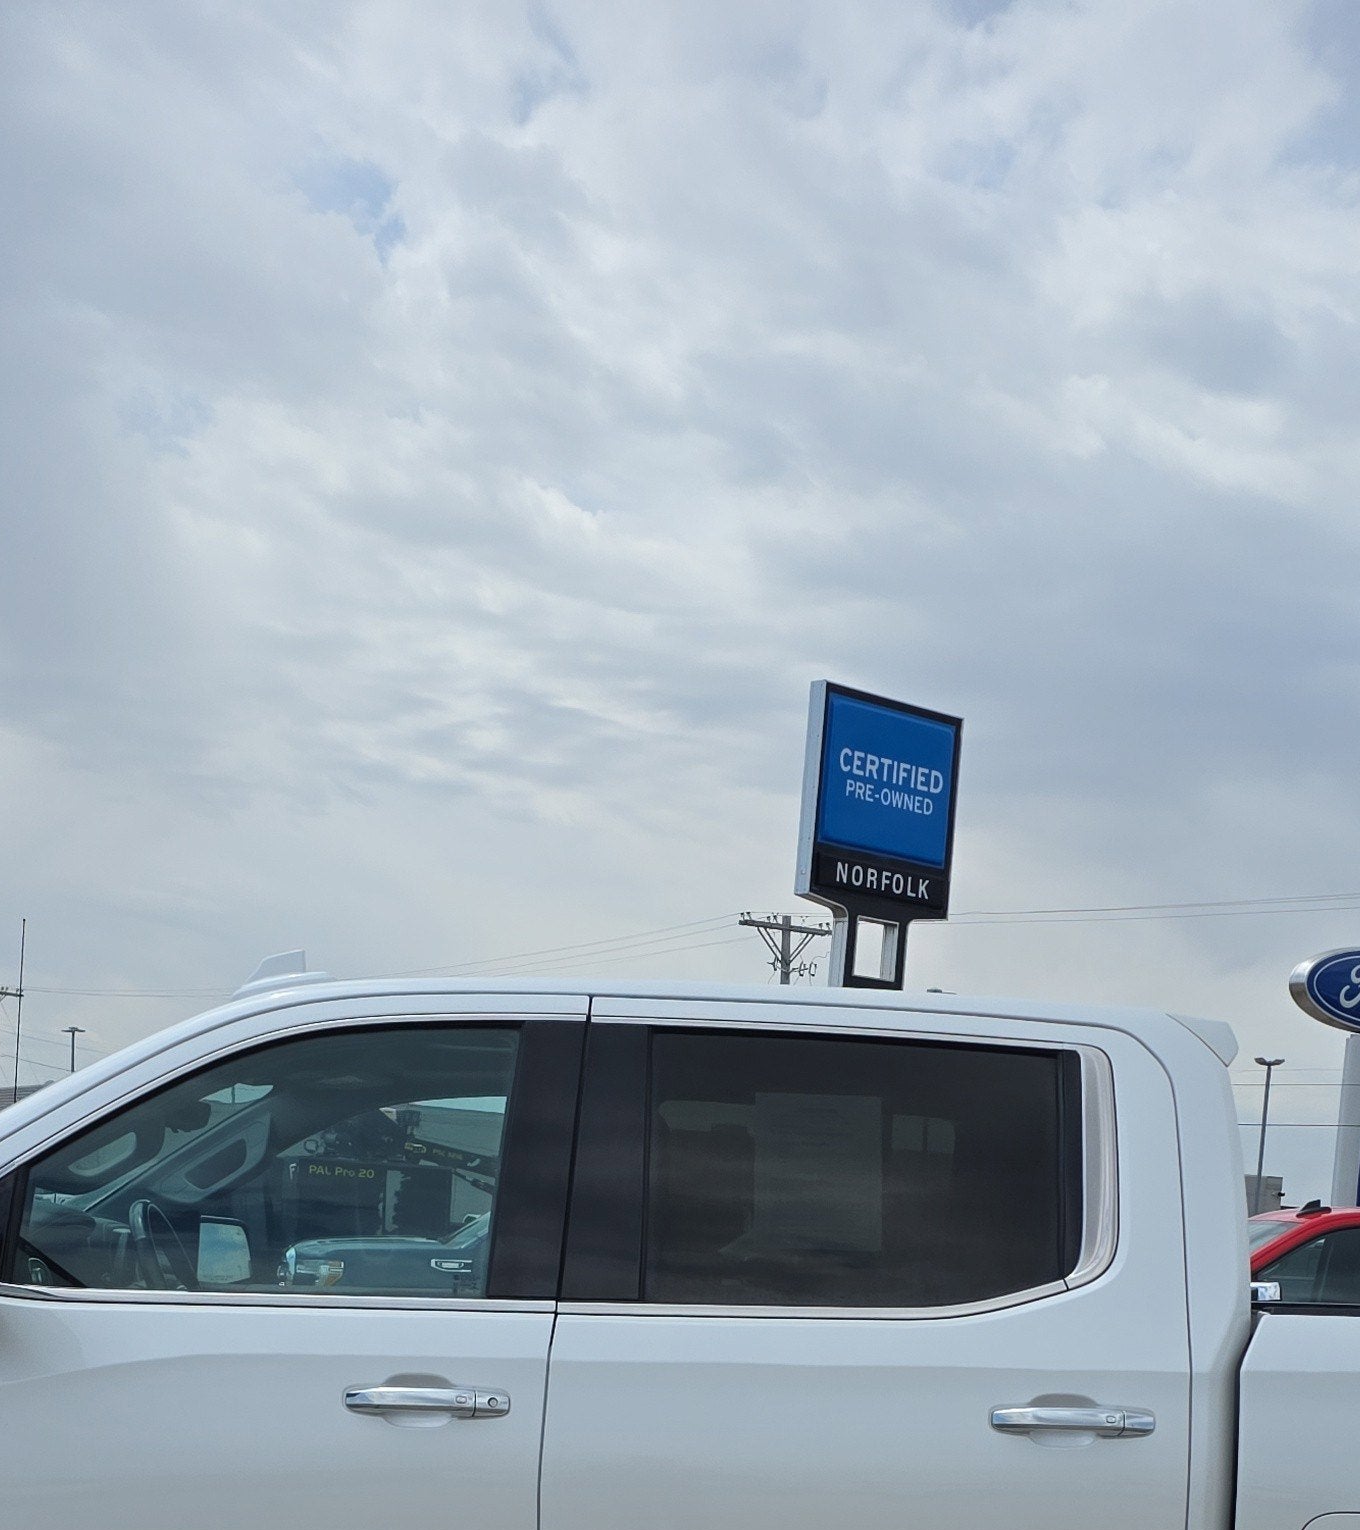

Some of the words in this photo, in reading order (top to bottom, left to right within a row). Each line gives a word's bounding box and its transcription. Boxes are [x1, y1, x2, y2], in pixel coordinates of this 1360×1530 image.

[840, 748, 943, 794] CERTIFIED
[845, 780, 933, 815] PRE-OWNED
[836, 861, 930, 899] NORFOLK
[309, 1165, 332, 1175] PAL
[358, 1168, 375, 1178] 20
